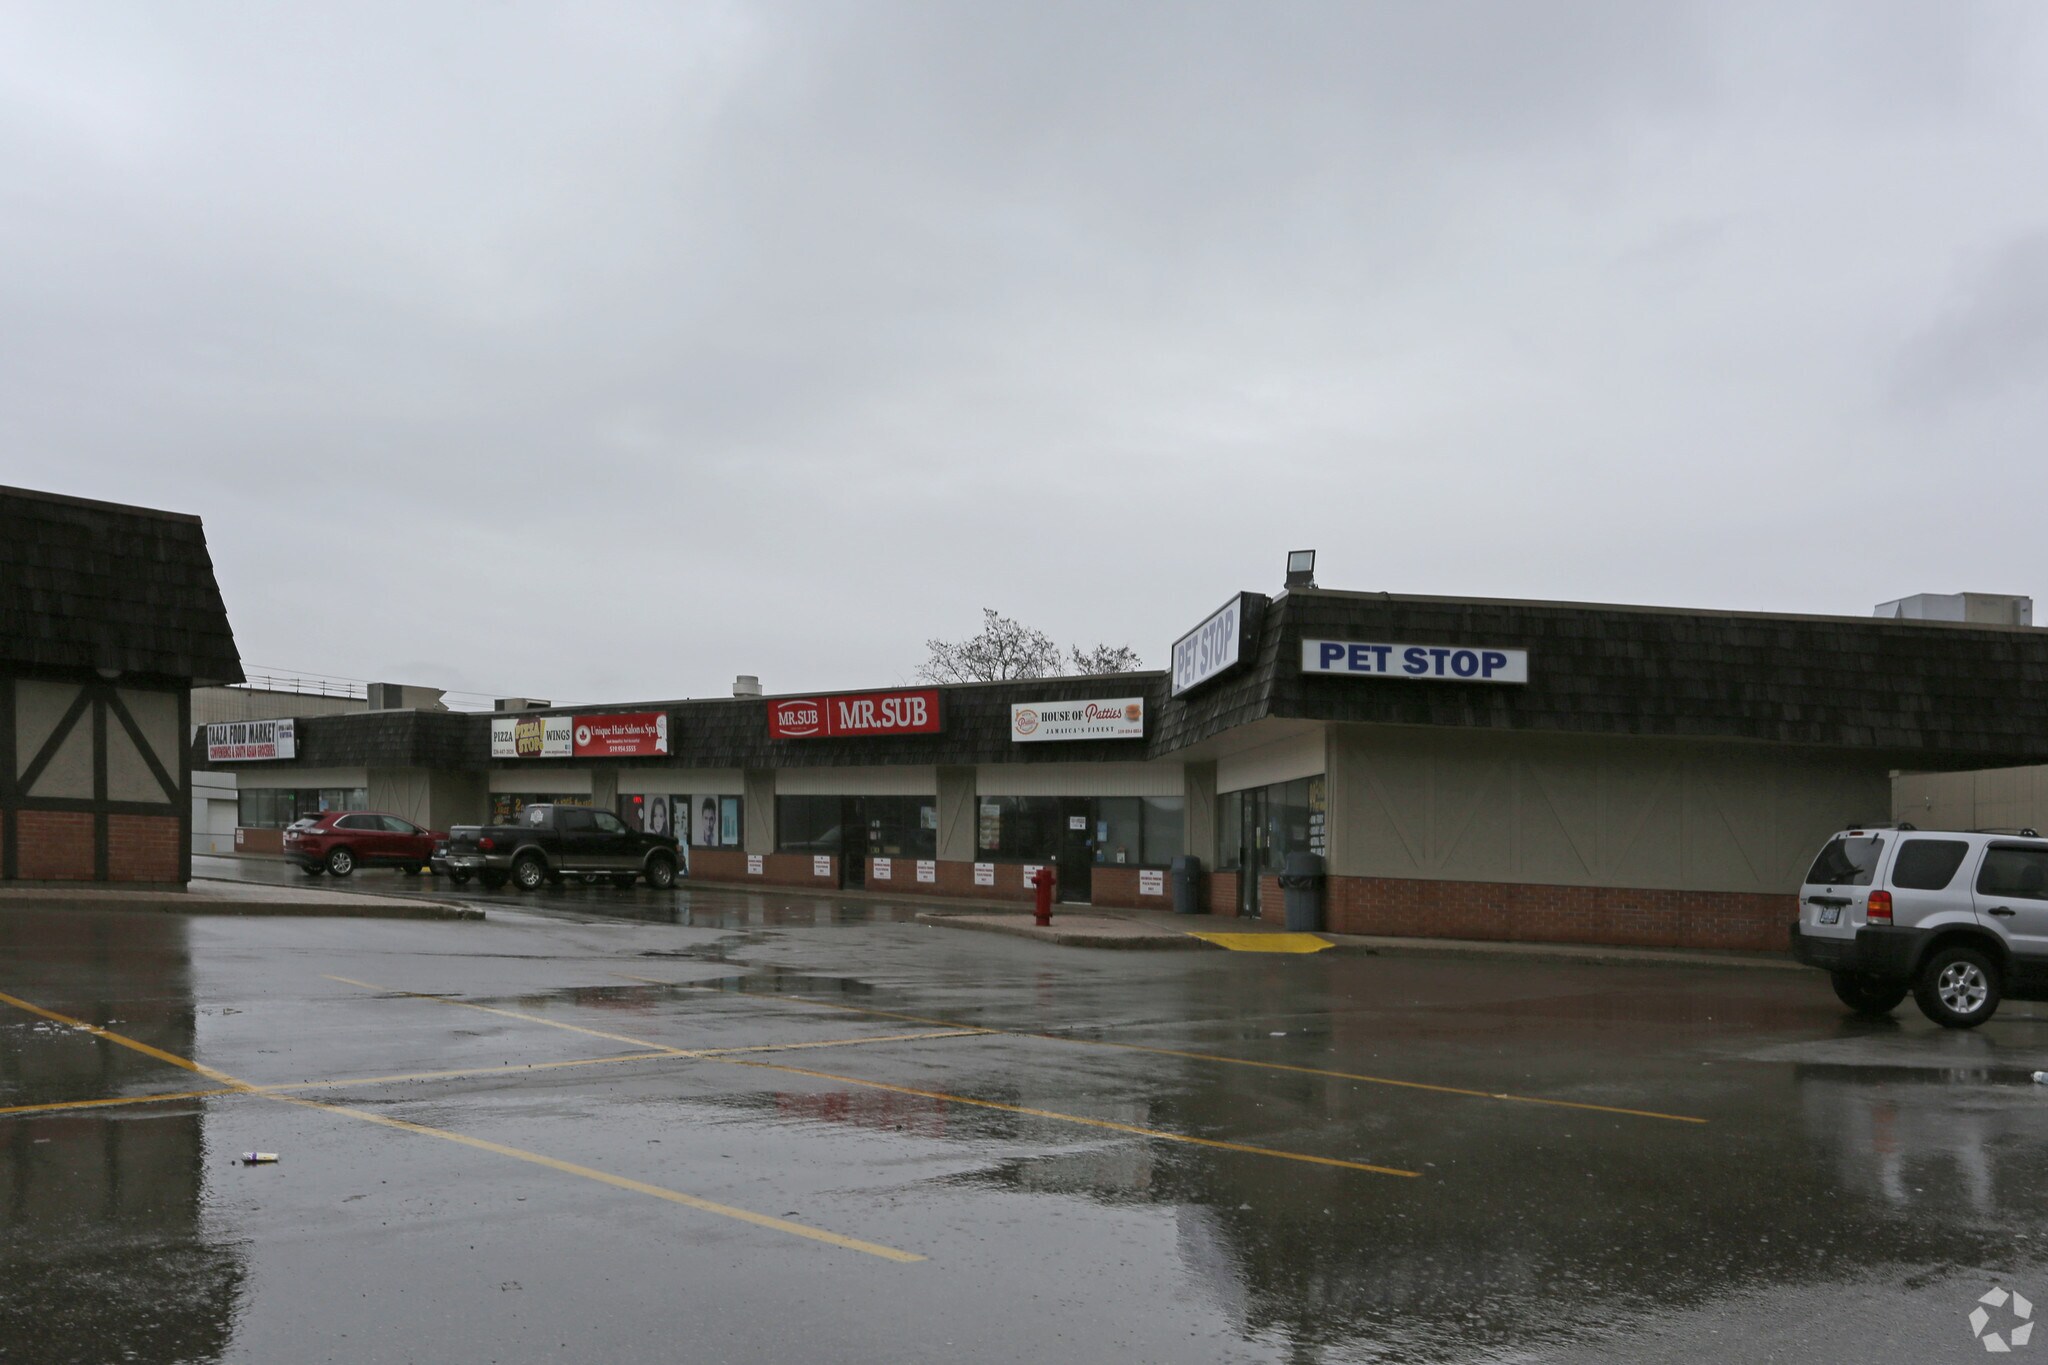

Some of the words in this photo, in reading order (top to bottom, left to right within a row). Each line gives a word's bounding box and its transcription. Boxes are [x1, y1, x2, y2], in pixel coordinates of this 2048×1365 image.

[1177, 634, 1199, 690] PET
[1200, 608, 1234, 674] STOP
[1320, 642, 1393, 673] PET
[1402, 646, 1508, 678] STOP
[778, 710, 818, 726] MR.SUB
[838, 697, 928, 729] MR.SUB
[1041, 711, 1071, 722] HOUSE
[1072, 710, 1083, 721] OF
[1085, 703, 1122, 723] Patties
[209, 725, 228, 746] TAAZA
[229, 724, 247, 744] FOOD
[248, 722, 276, 743] MARKET
[493, 731, 513, 742] PIZZA
[515, 722, 540, 739] PIZZA
[546, 729, 570, 741] WINGS
[590, 725, 611, 739] Unique
[612, 724, 624, 735] Hair
[625, 723, 640, 734] Salon
[645, 723, 657, 737] Spa
[1046, 727, 1085, 735] JAMAICA'S
